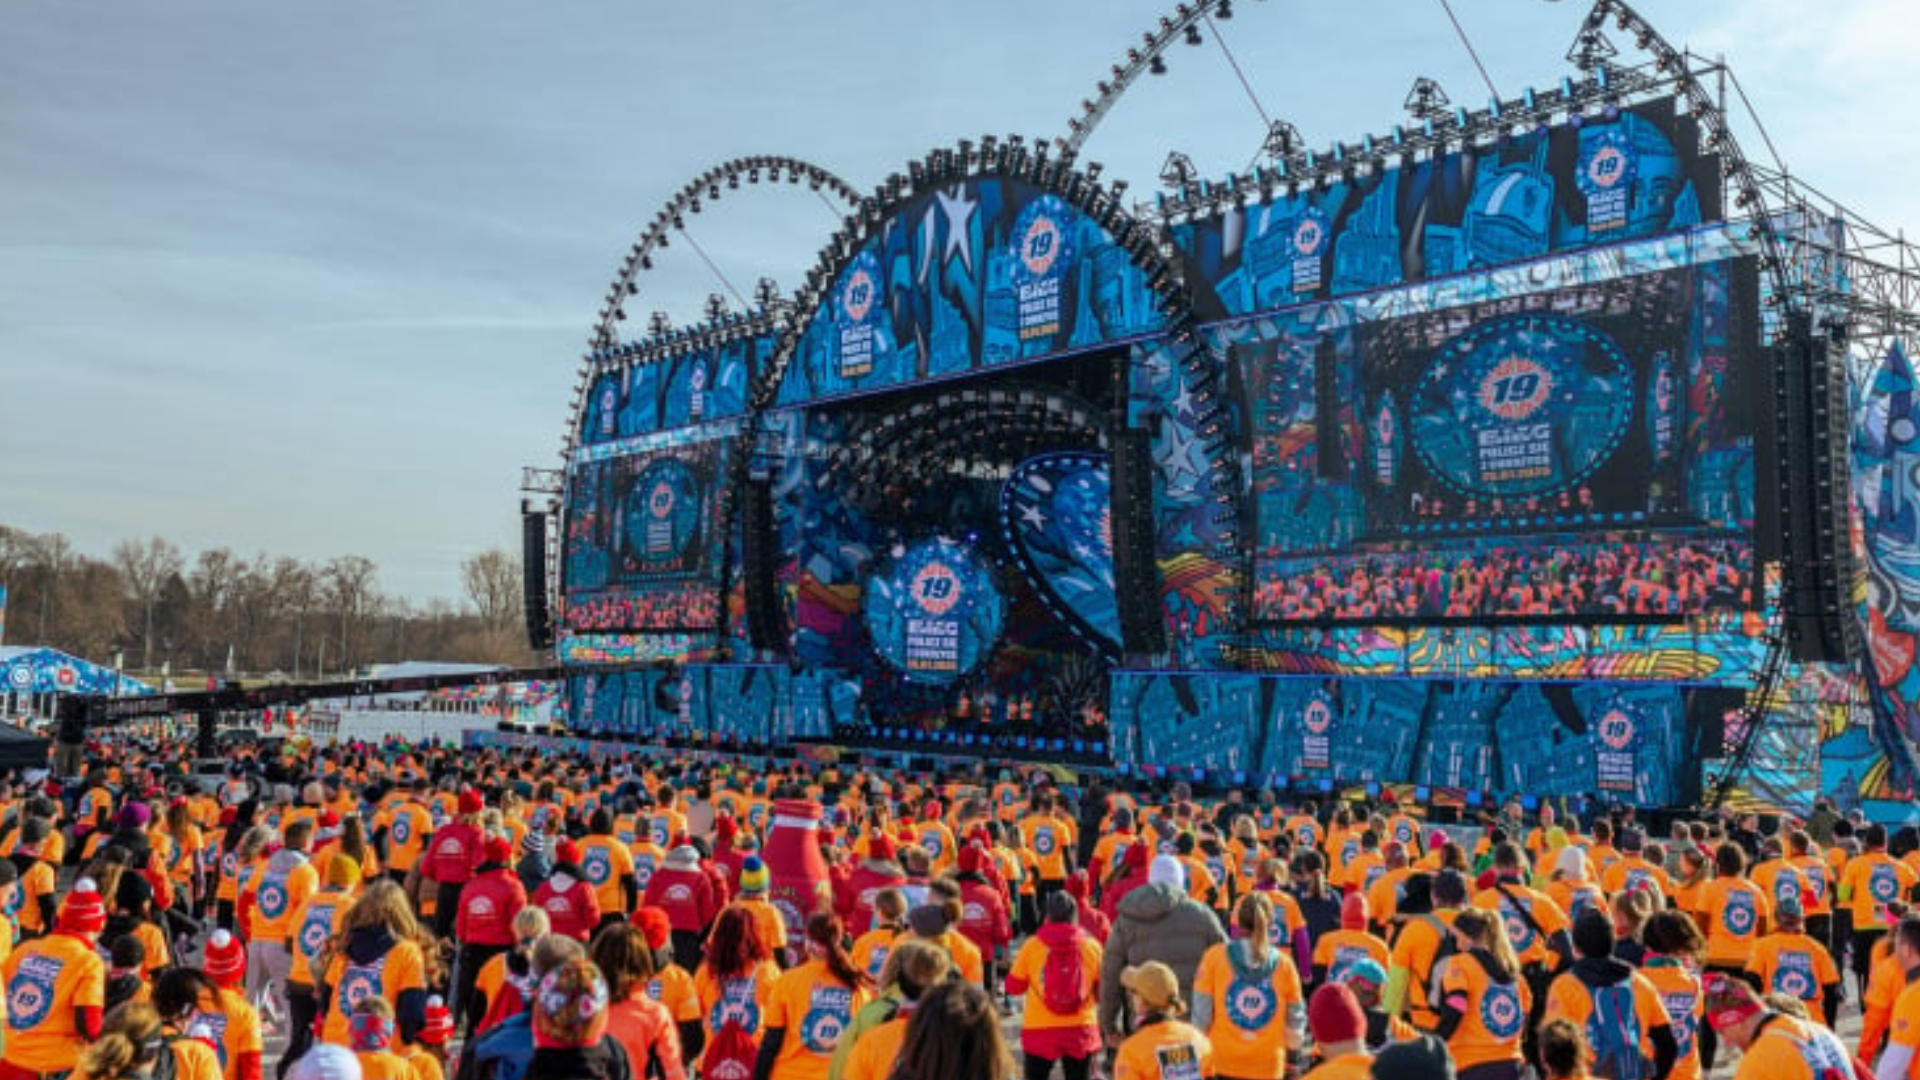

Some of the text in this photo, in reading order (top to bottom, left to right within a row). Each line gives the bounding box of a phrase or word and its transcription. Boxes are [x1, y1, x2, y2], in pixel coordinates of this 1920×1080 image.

[1596, 156, 1617, 176] 19
[1028, 231, 1053, 259] 19
[1493, 373, 1540, 403] 19
[921, 576, 953, 598] 19
[820, 1025, 837, 1038] 19
